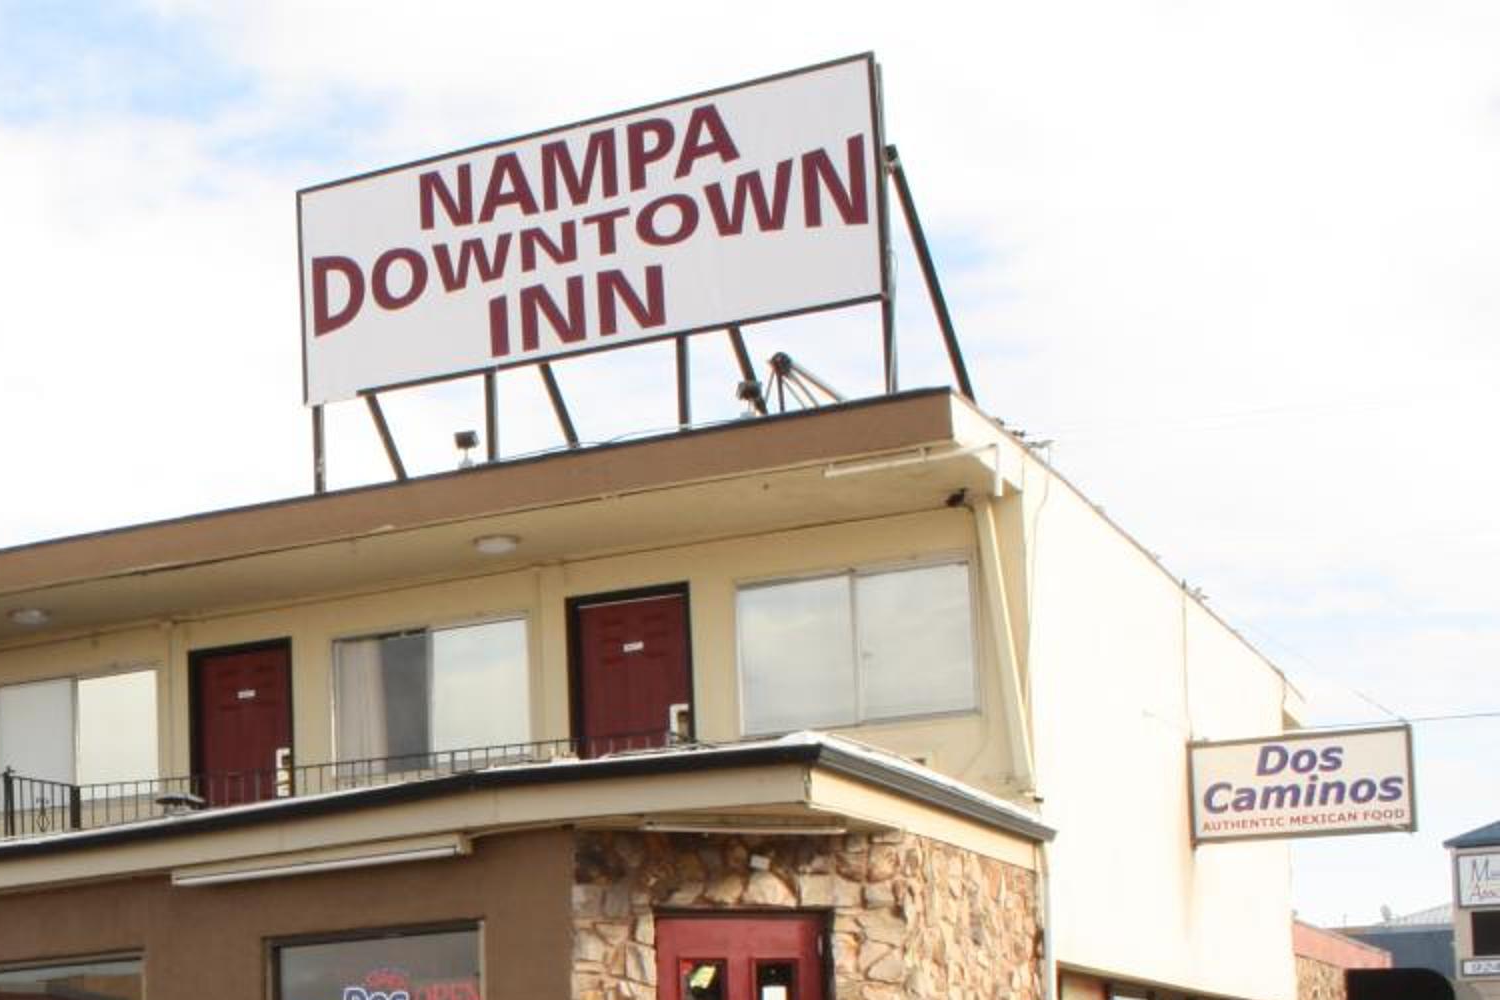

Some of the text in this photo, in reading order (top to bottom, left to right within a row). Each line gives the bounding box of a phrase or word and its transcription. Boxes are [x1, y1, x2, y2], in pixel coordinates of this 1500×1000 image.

[419, 103, 740, 230] NAMPA
[311, 133, 869, 338] DOWNTOWN
[488, 265, 667, 357] INN
[1256, 744, 1344, 777] Dos
[1203, 775, 1404, 814] Caminos
[1203, 808, 1406, 832] AUTHENTIC MEXICAN FOOD
